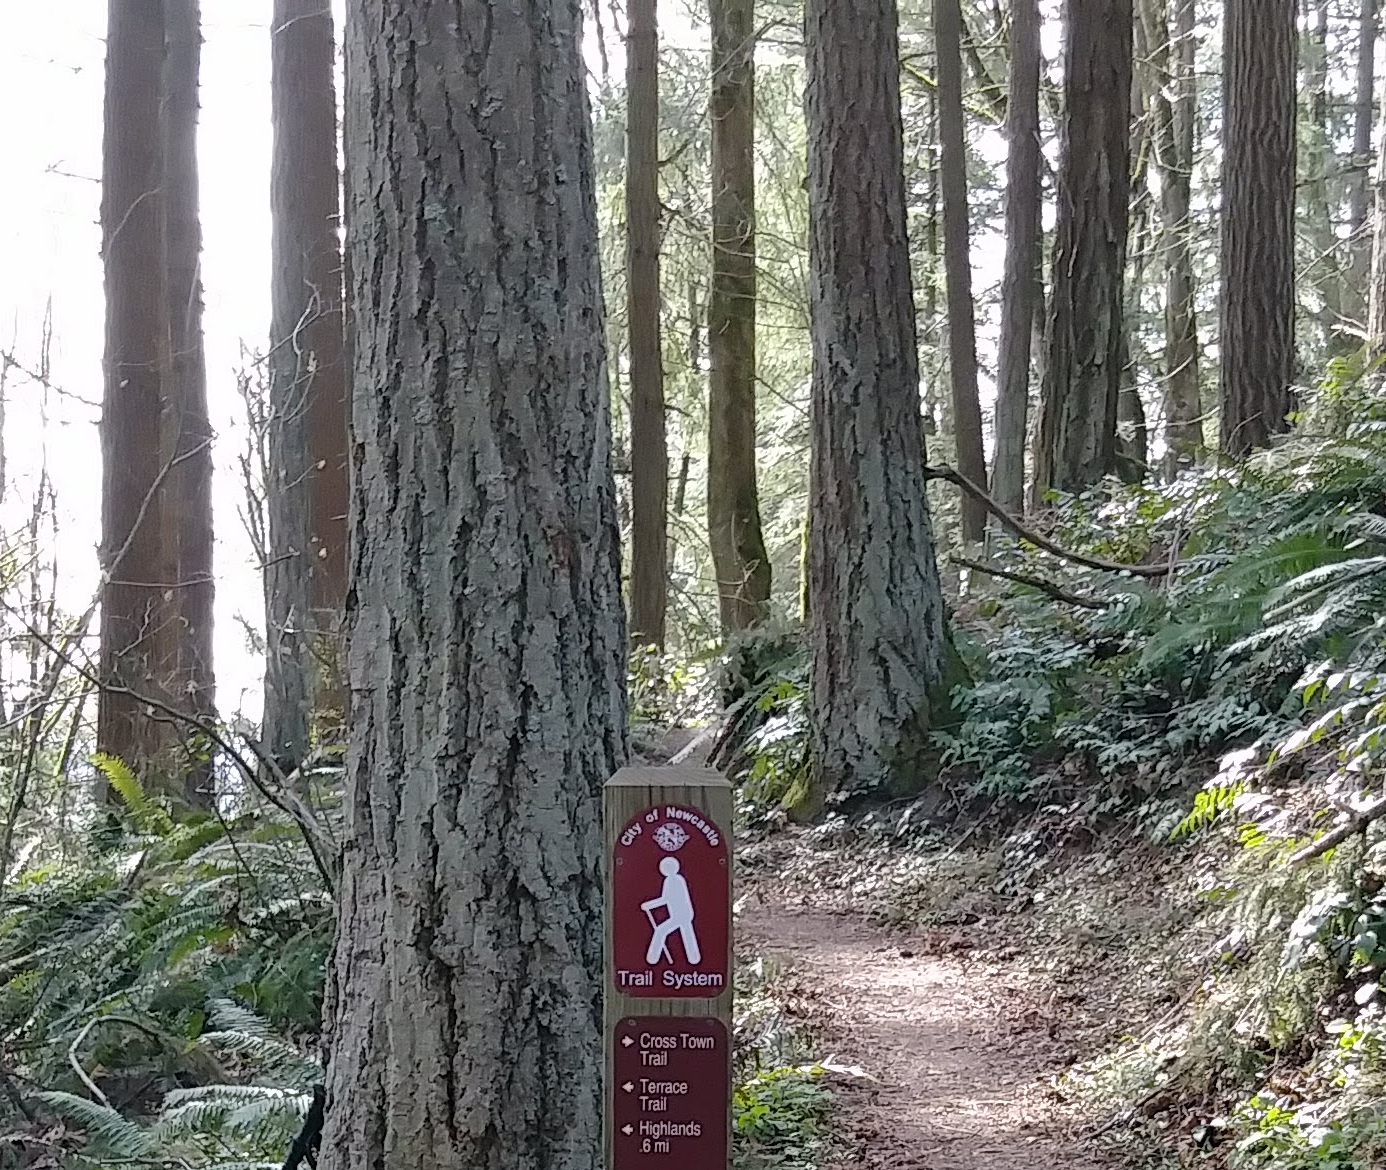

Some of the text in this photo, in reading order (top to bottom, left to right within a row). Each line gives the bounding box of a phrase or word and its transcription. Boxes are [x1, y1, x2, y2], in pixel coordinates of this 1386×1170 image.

[621, 822, 643, 846] City
[645, 808, 659, 823] of
[666, 806, 720, 847] Newcastle
[618, 970, 723, 990] Trail System
[639, 1033, 714, 1049] Cross Town
[640, 1051, 668, 1066] Trail
[639, 1079, 688, 1094] Terrace
[639, 1096, 667, 1111] Trail
[639, 1120, 701, 1139] Highlands
[639, 1138, 670, 1153] .6 mi
